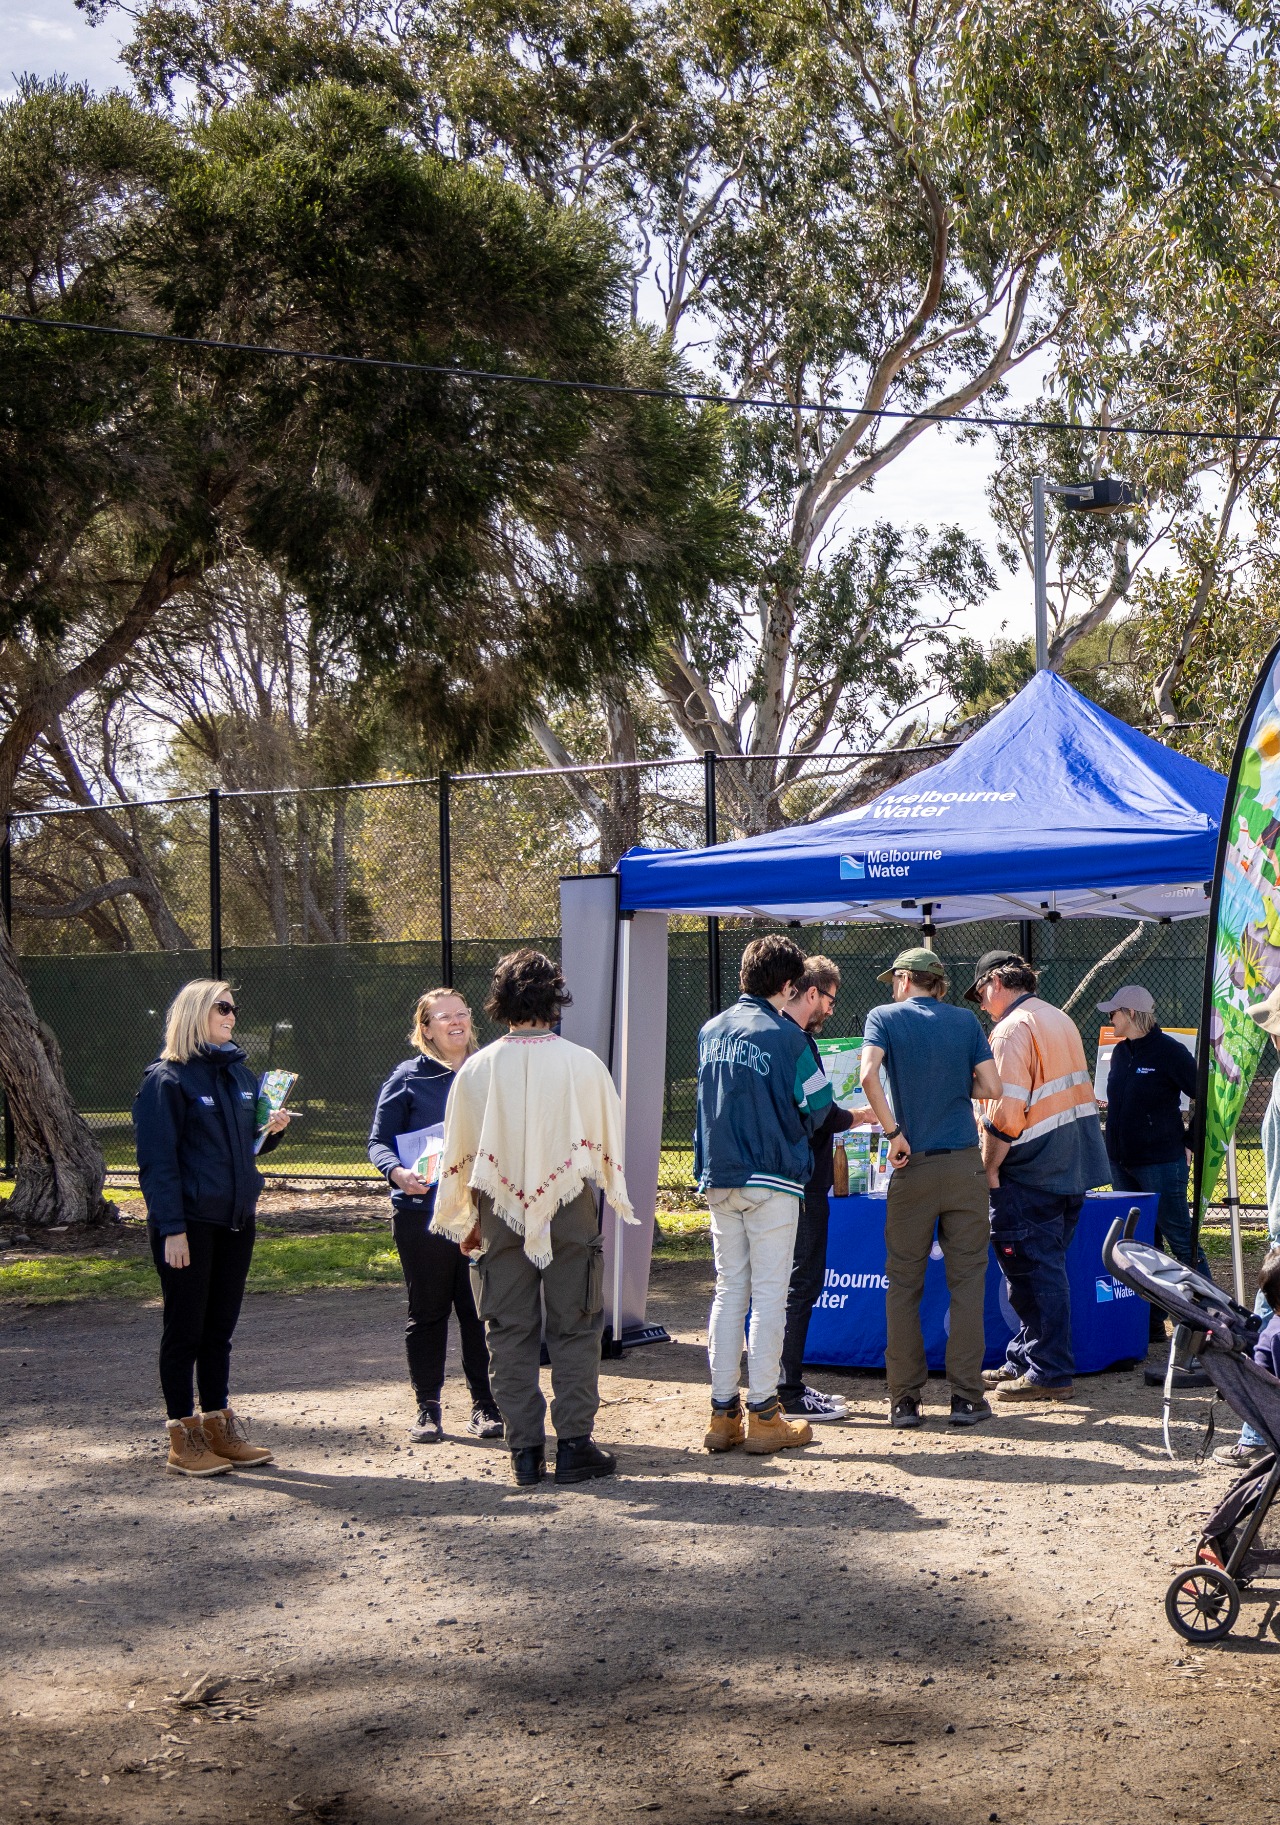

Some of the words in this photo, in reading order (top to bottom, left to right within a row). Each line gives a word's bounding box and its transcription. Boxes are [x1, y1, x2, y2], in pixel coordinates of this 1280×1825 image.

[880, 791, 1016, 805] Melbourne
[873, 805, 951, 819] Water
[867, 849, 942, 863] Melbourne
[868, 864, 910, 878] Water
[823, 1268, 889, 1289] lbourne
[812, 1291, 848, 1308] ter
